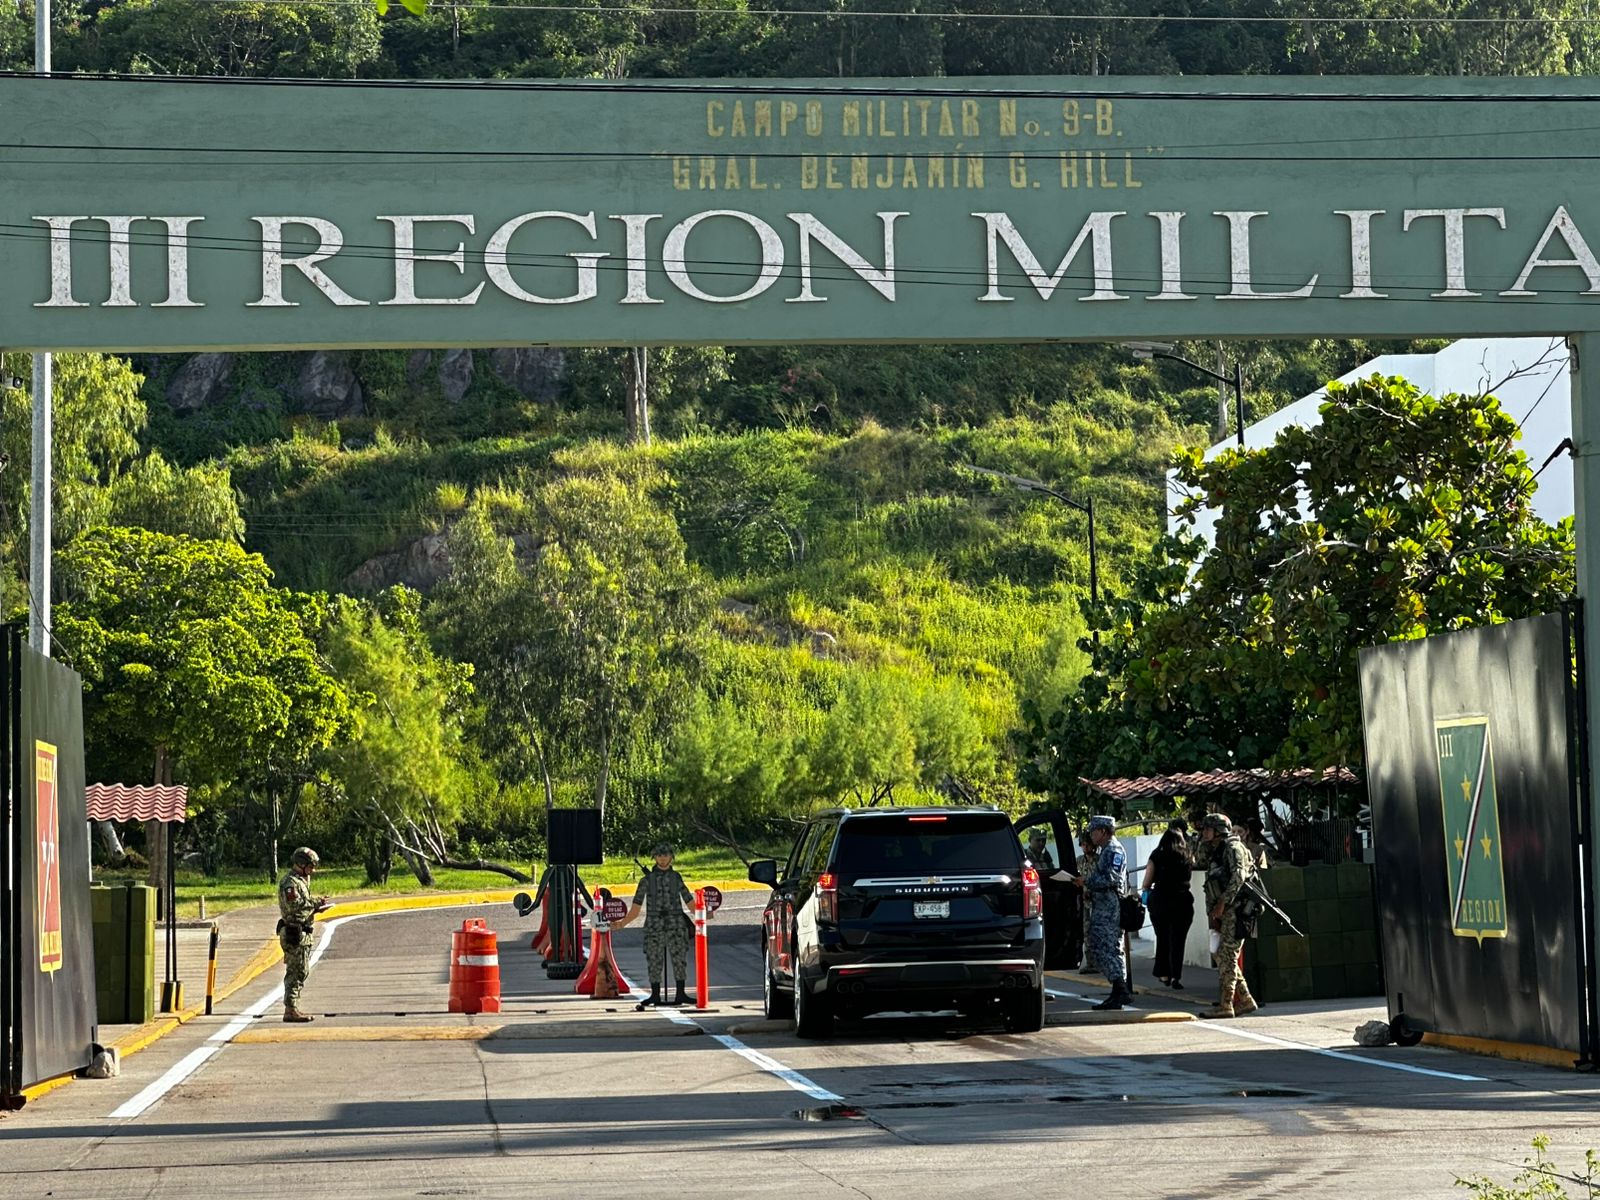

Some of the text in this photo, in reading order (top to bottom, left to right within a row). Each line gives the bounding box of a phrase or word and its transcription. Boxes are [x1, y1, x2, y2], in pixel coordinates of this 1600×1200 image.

[706, 99, 823, 138] CAMPO
[842, 98, 981, 138] MILITAR
[999, 98, 1051, 137] No.
[801, 143, 985, 189] BENJAMÍN
[1009, 152, 1041, 189] G.
[33, 214, 206, 308] III
[246, 210, 911, 308] REGION
[1440, 734, 1453, 758] III
[1461, 899, 1501, 923] REGION
